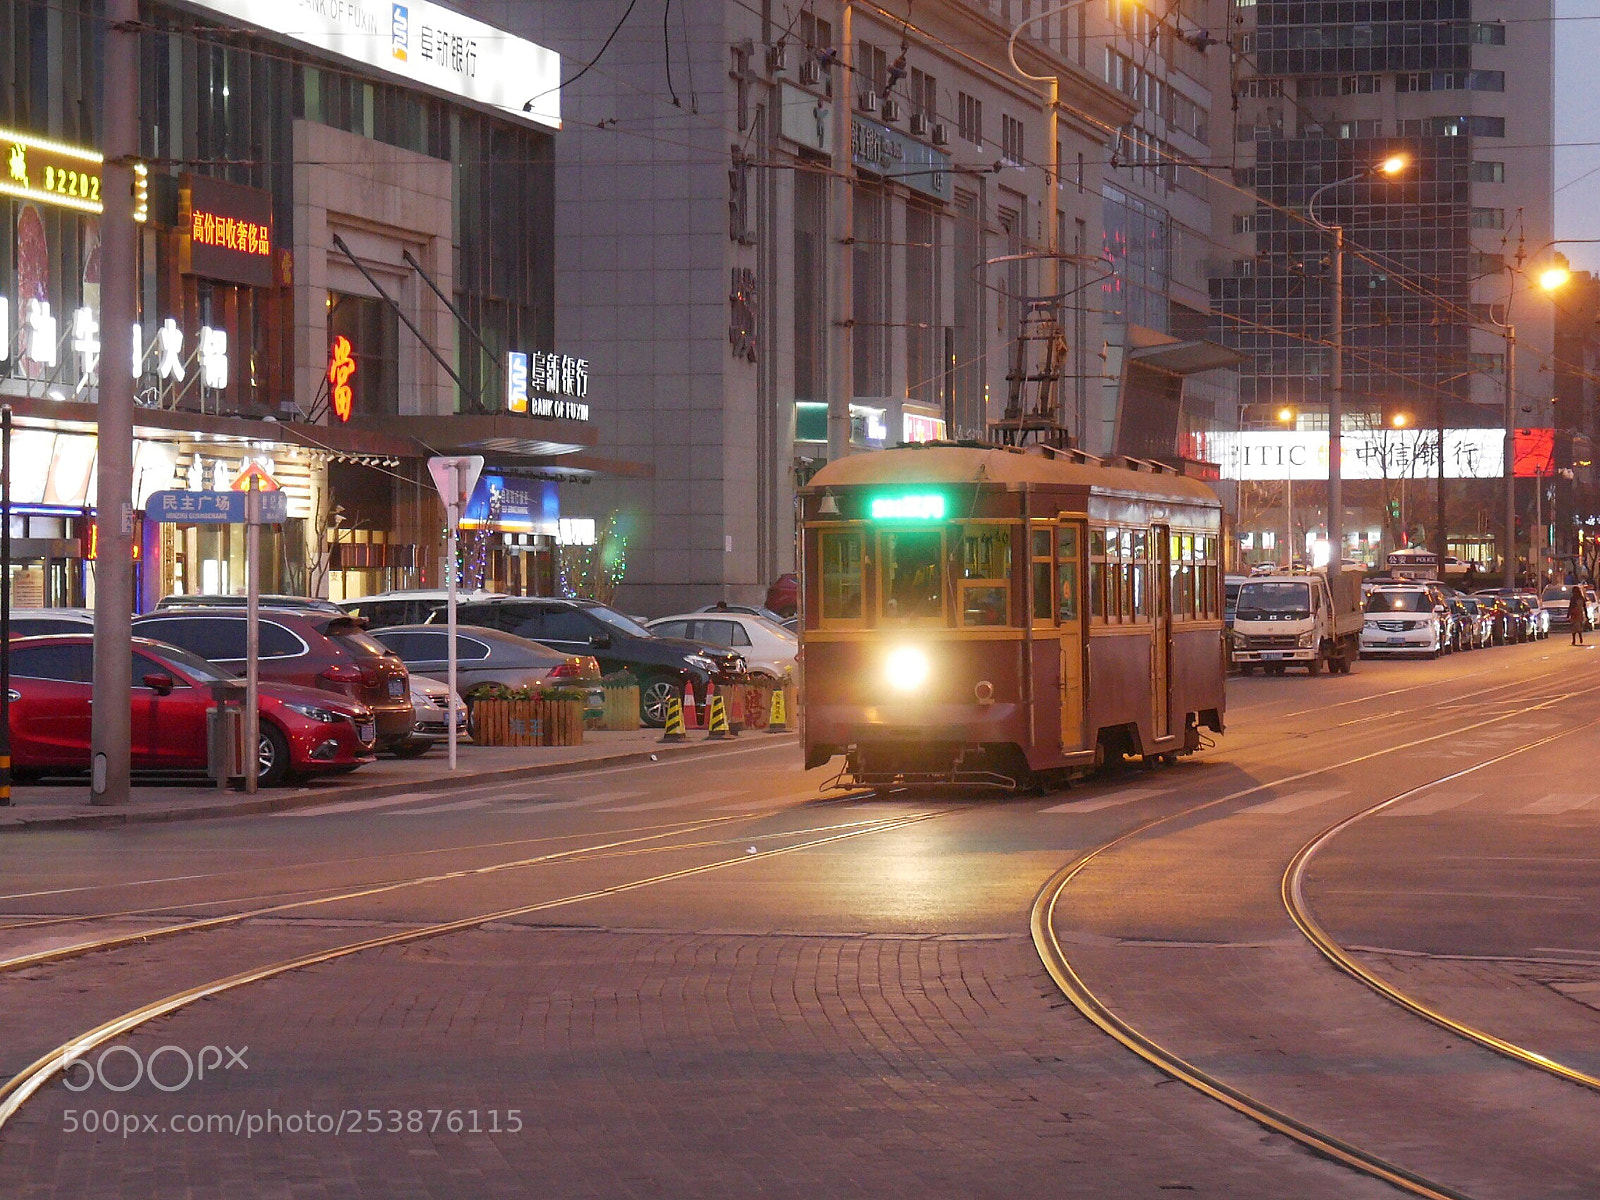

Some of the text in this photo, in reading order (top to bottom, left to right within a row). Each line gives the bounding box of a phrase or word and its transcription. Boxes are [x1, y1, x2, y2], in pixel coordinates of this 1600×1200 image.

[348, 3, 378, 35] FUXIN
[421, 25, 477, 78] 阜新银行
[193, 210, 270, 256] 高价回收奢侈品
[532, 351, 589, 397] 阜新银行
[531, 398, 589, 421] BANK OF FUXIN
[162, 494, 230, 512] 民主广场
[1389, 555, 1437, 564] 公安 POLICE
